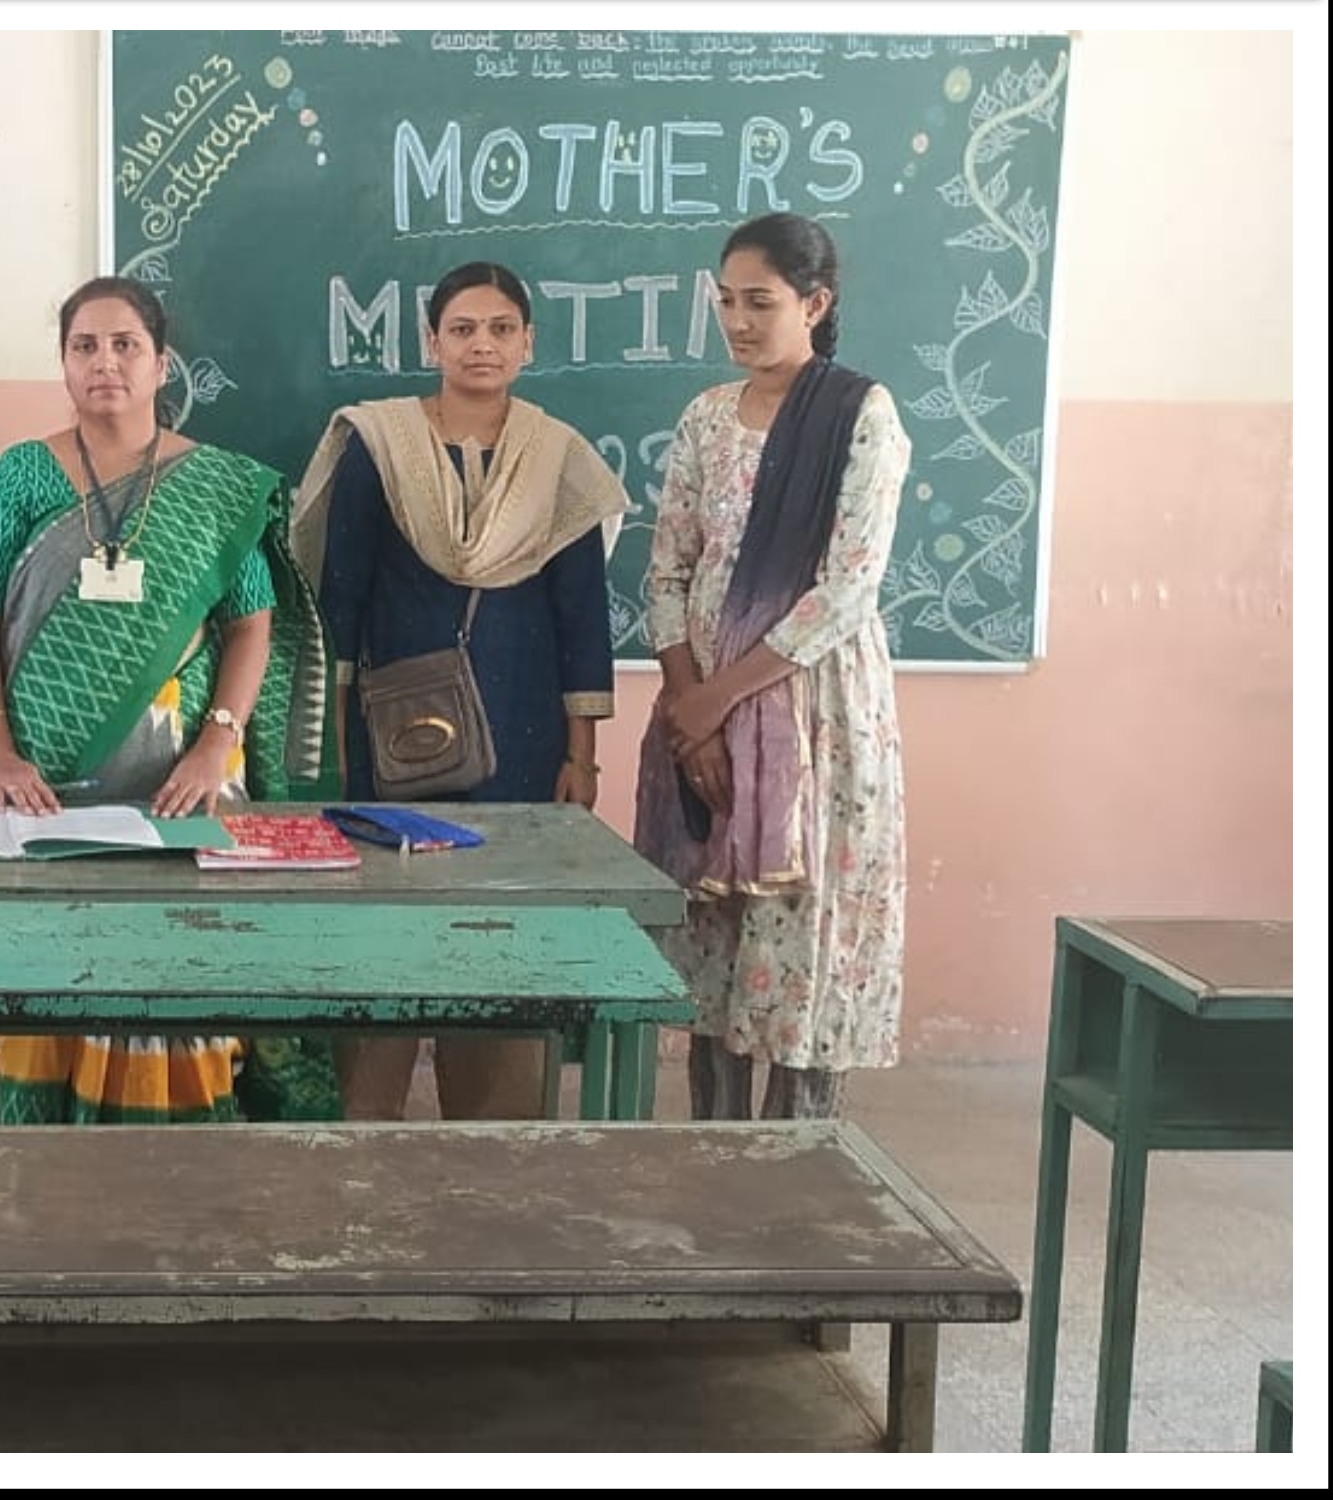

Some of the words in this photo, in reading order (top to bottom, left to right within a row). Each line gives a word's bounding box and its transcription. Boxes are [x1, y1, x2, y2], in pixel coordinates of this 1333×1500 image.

[633, 55, 712, 78] neglected
[141, 90, 273, 242] Saturday
[393, 105, 865, 232] MOTHER'S
